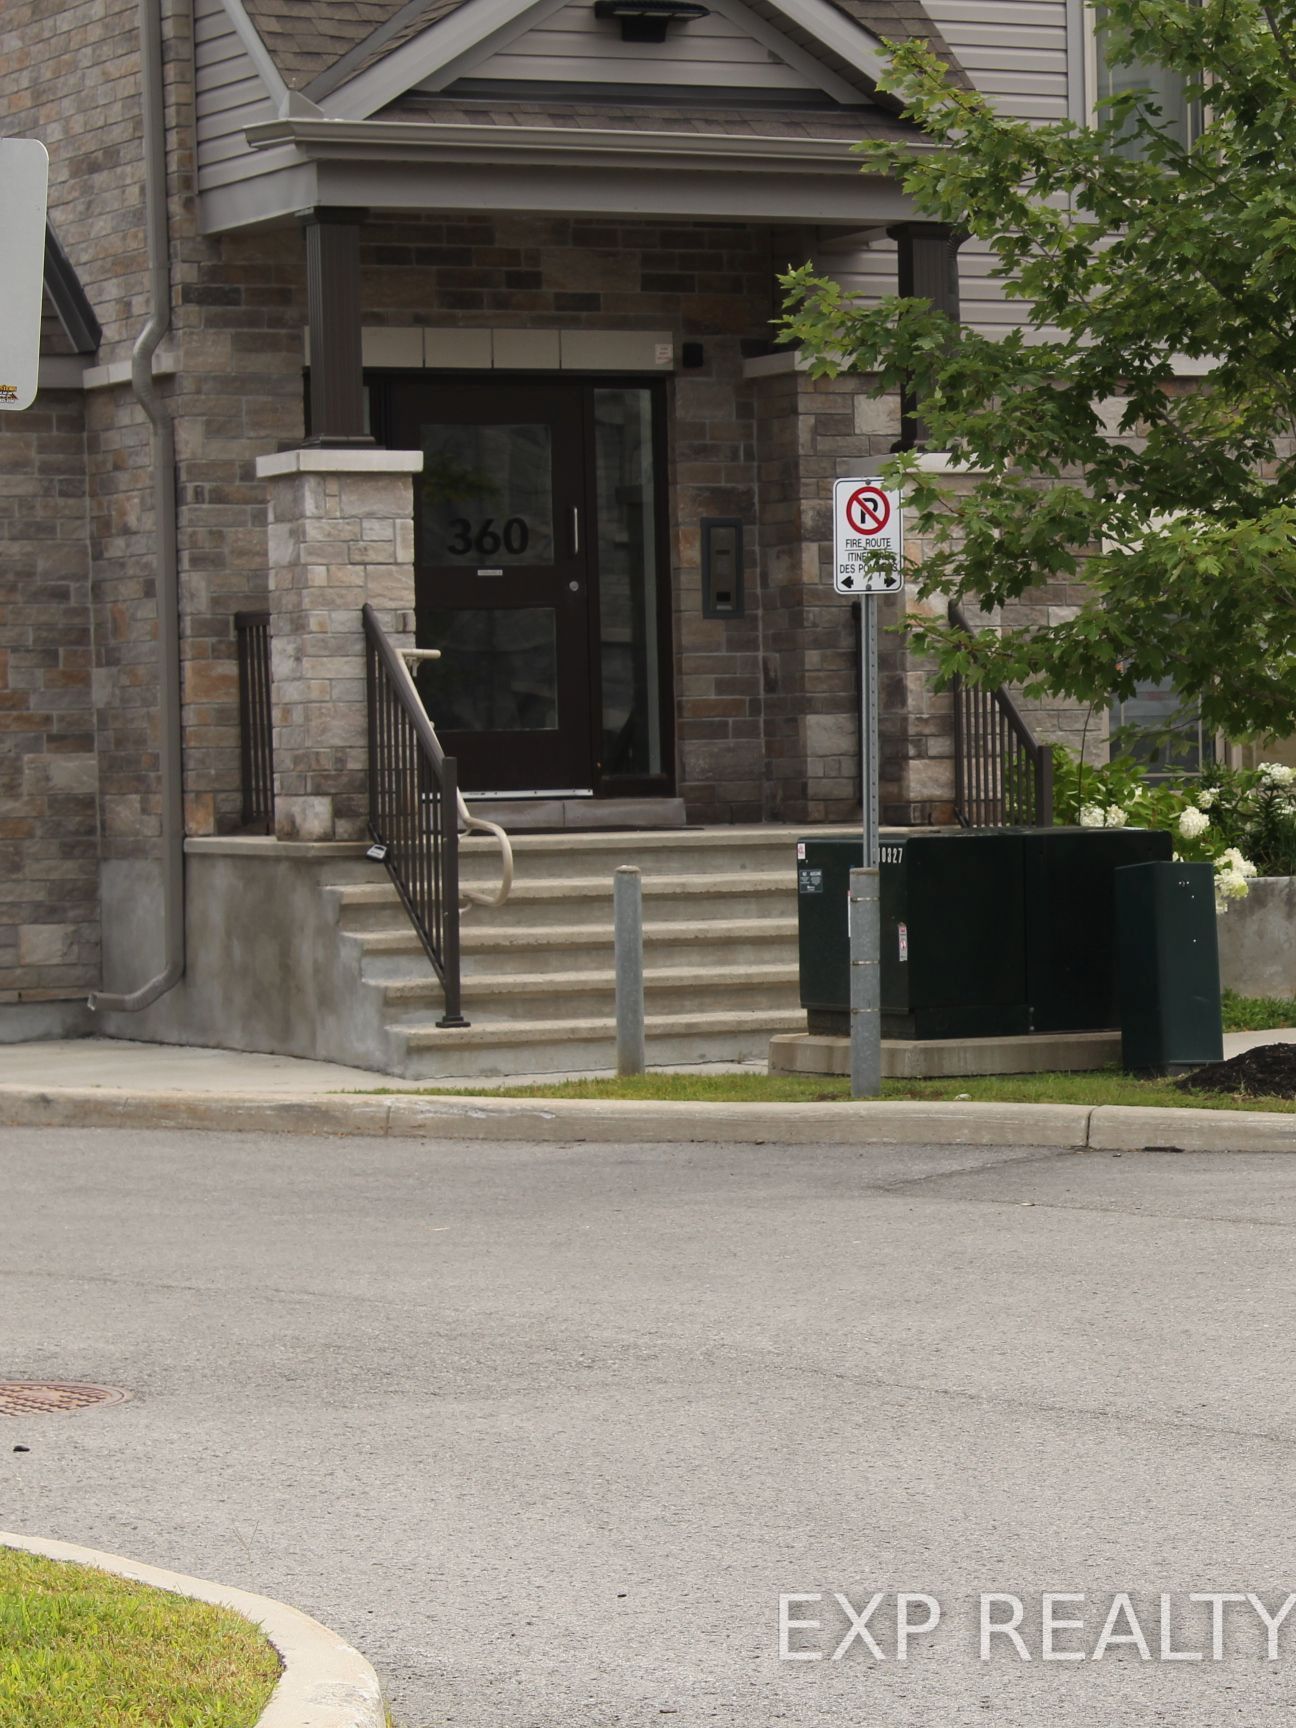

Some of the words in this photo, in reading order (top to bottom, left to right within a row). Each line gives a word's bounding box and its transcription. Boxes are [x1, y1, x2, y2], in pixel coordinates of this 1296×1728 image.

[447, 517, 529, 556] 360
[845, 538, 863, 548] FIRE
[866, 537, 891, 548] ROUTE
[839, 563, 856, 574] DES
[878, 846, 903, 864] 0327
